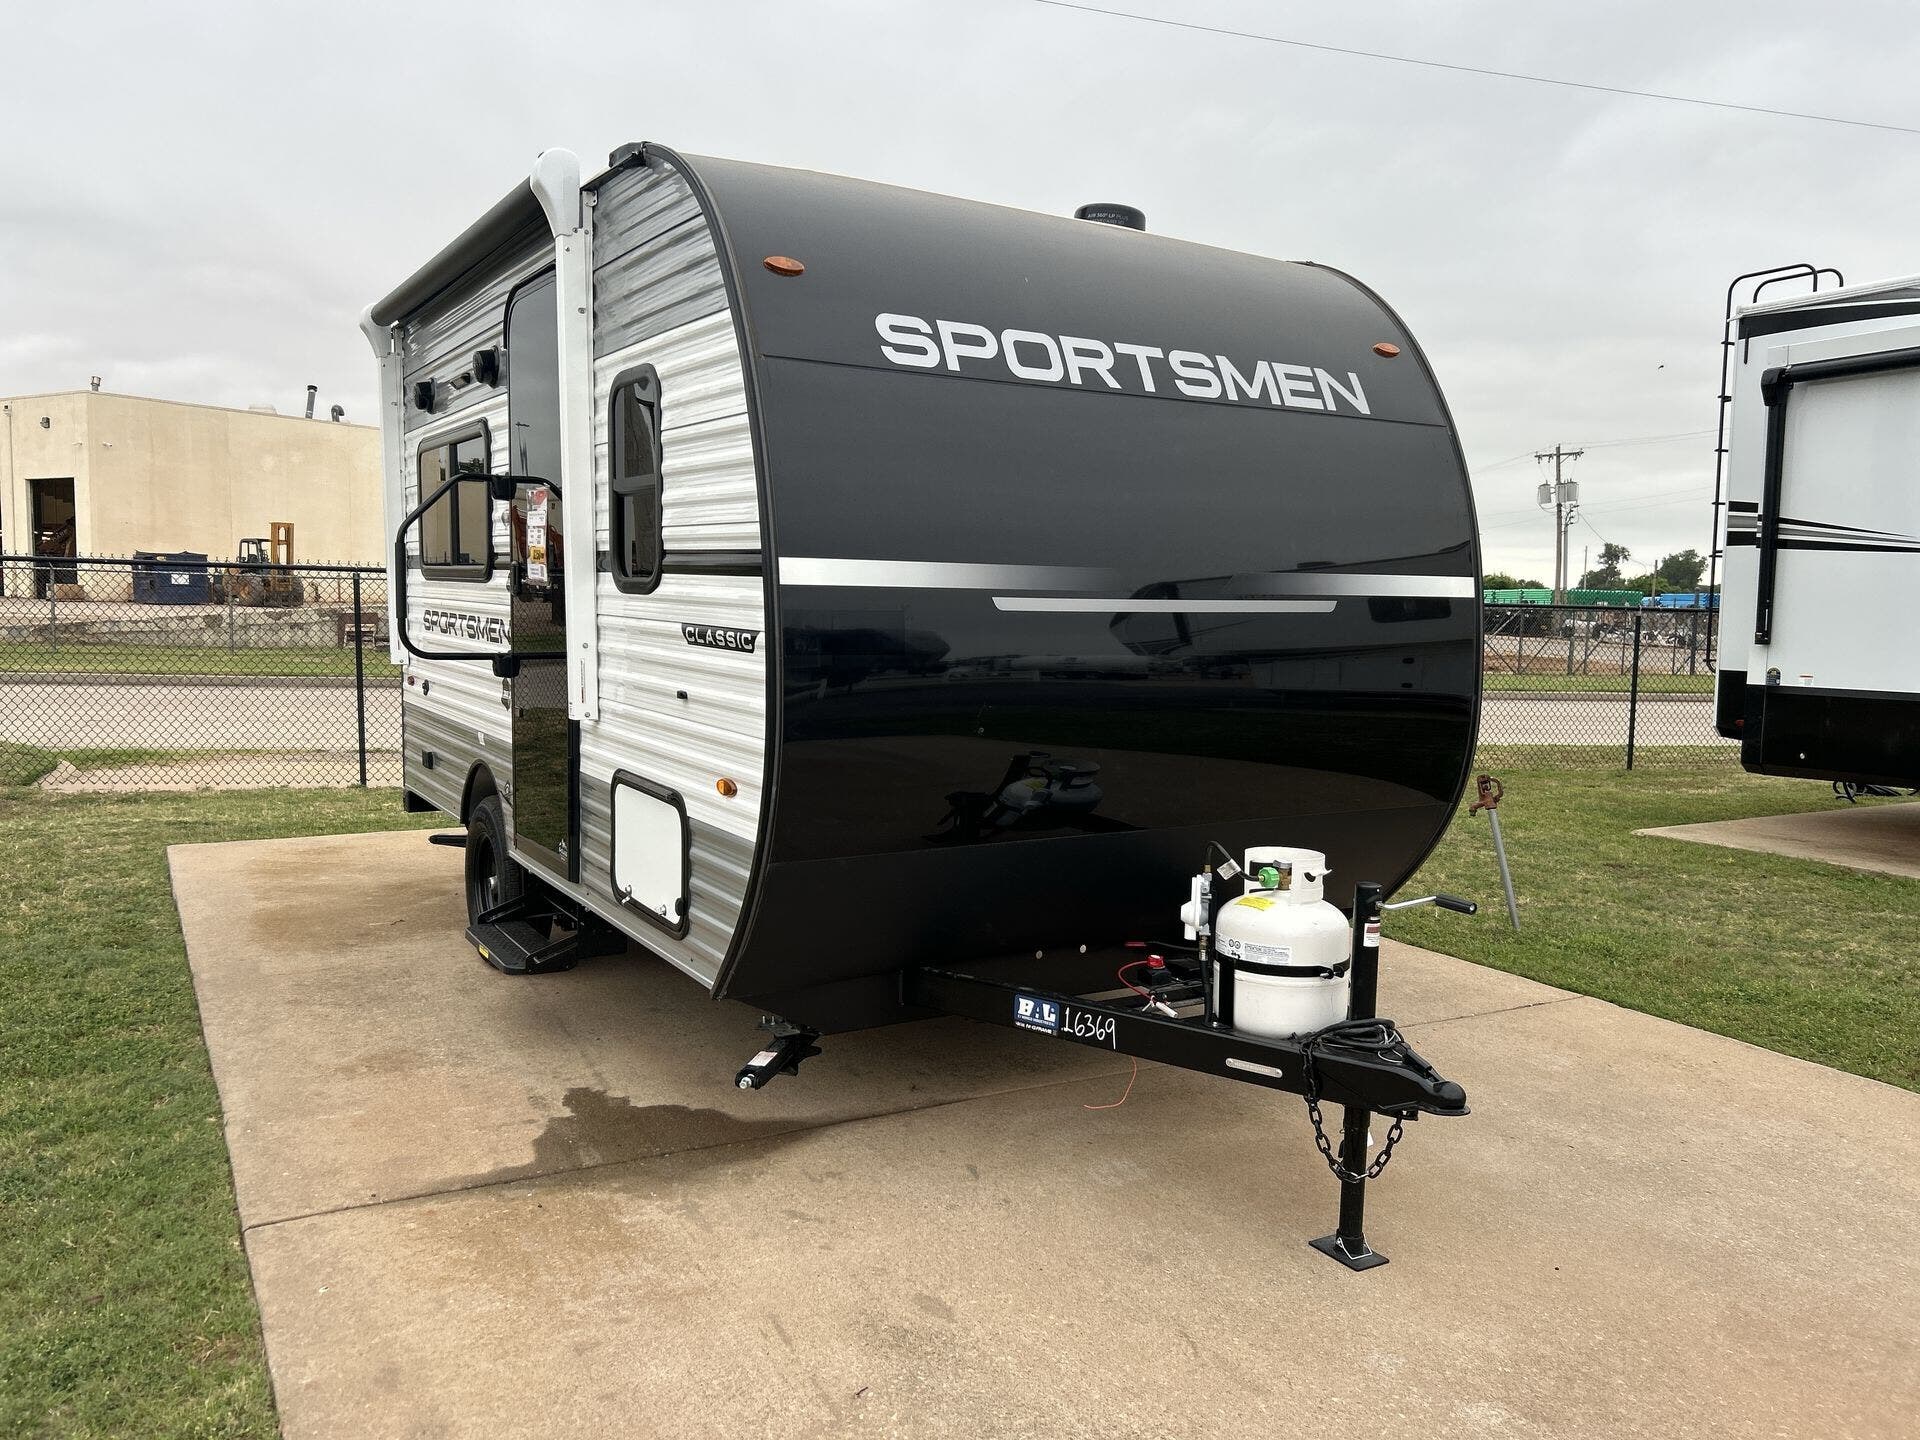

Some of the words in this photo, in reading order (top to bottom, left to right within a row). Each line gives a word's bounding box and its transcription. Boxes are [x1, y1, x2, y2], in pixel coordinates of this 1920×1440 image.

[874, 312, 1371, 415] SPORTSMEN
[423, 609, 511, 645] SPORTSMEN
[685, 626, 753, 650] CLASSIC
[1061, 1006, 1116, 1050] 16369
